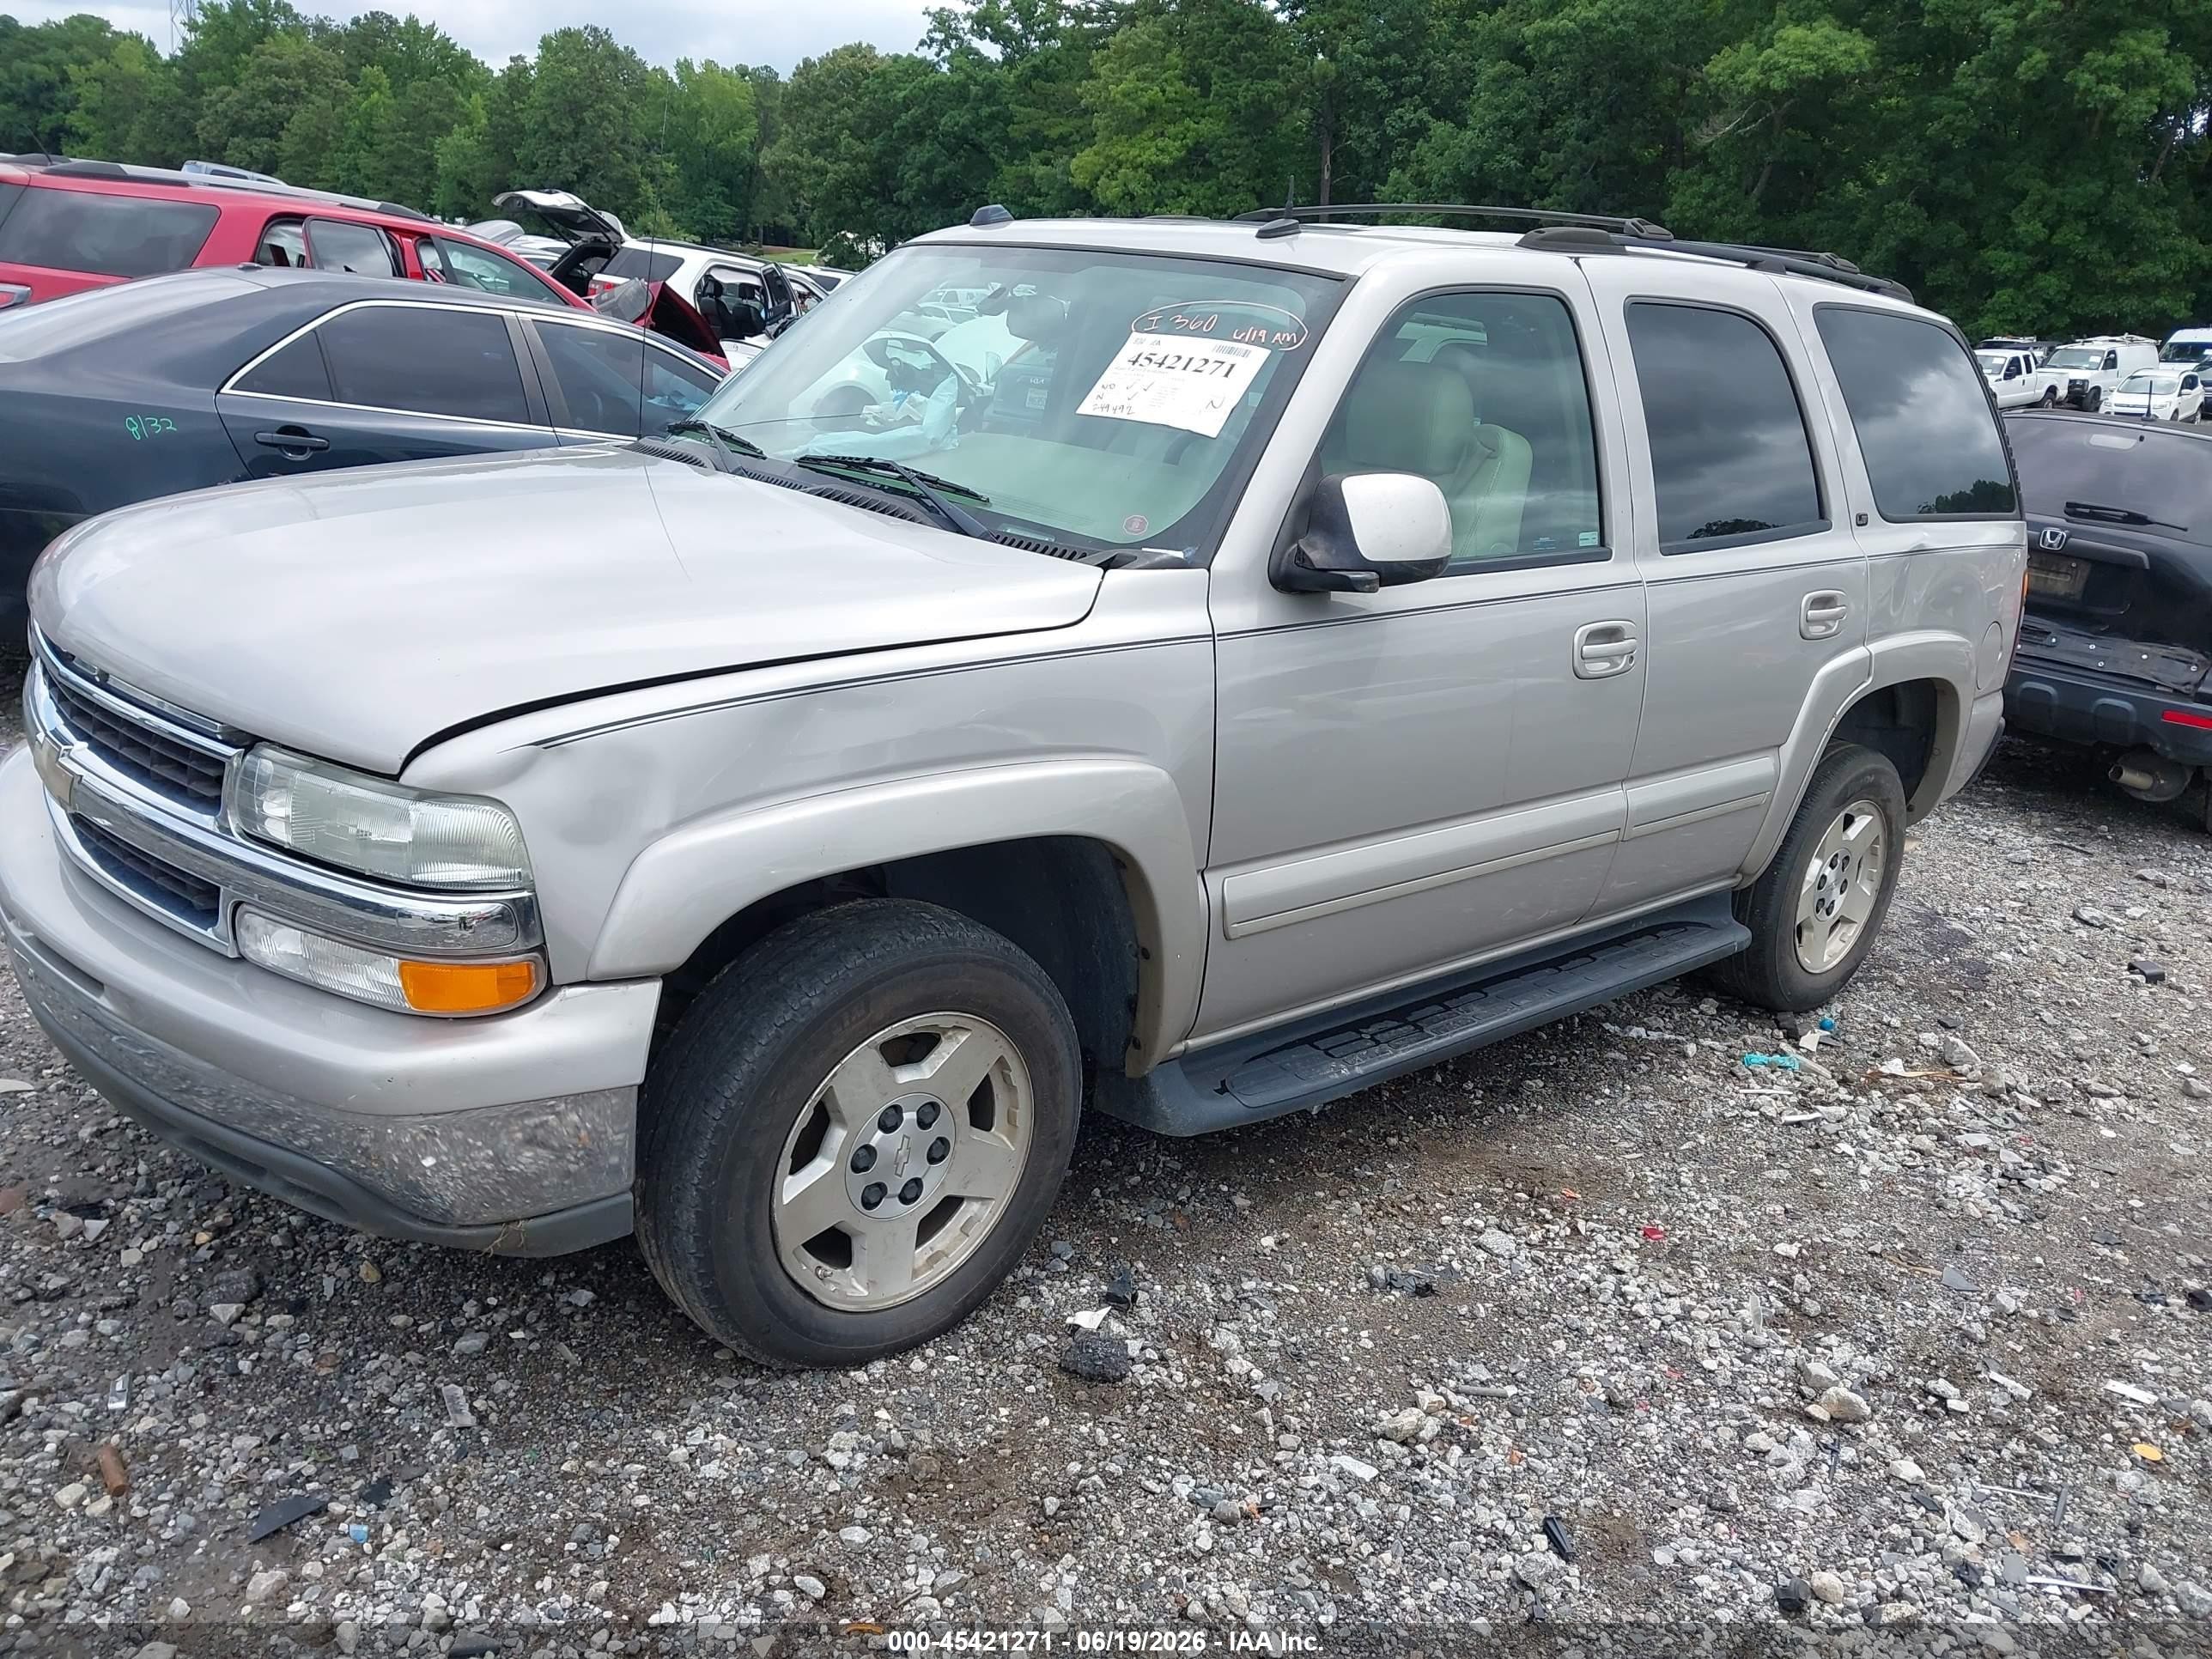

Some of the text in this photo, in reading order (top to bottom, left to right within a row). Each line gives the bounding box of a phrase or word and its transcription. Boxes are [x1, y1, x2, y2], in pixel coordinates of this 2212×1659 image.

[1170, 314, 1218, 332] 360
[1232, 326, 1297, 345] 6/19 AM
[1127, 351, 1237, 379] 45421271
